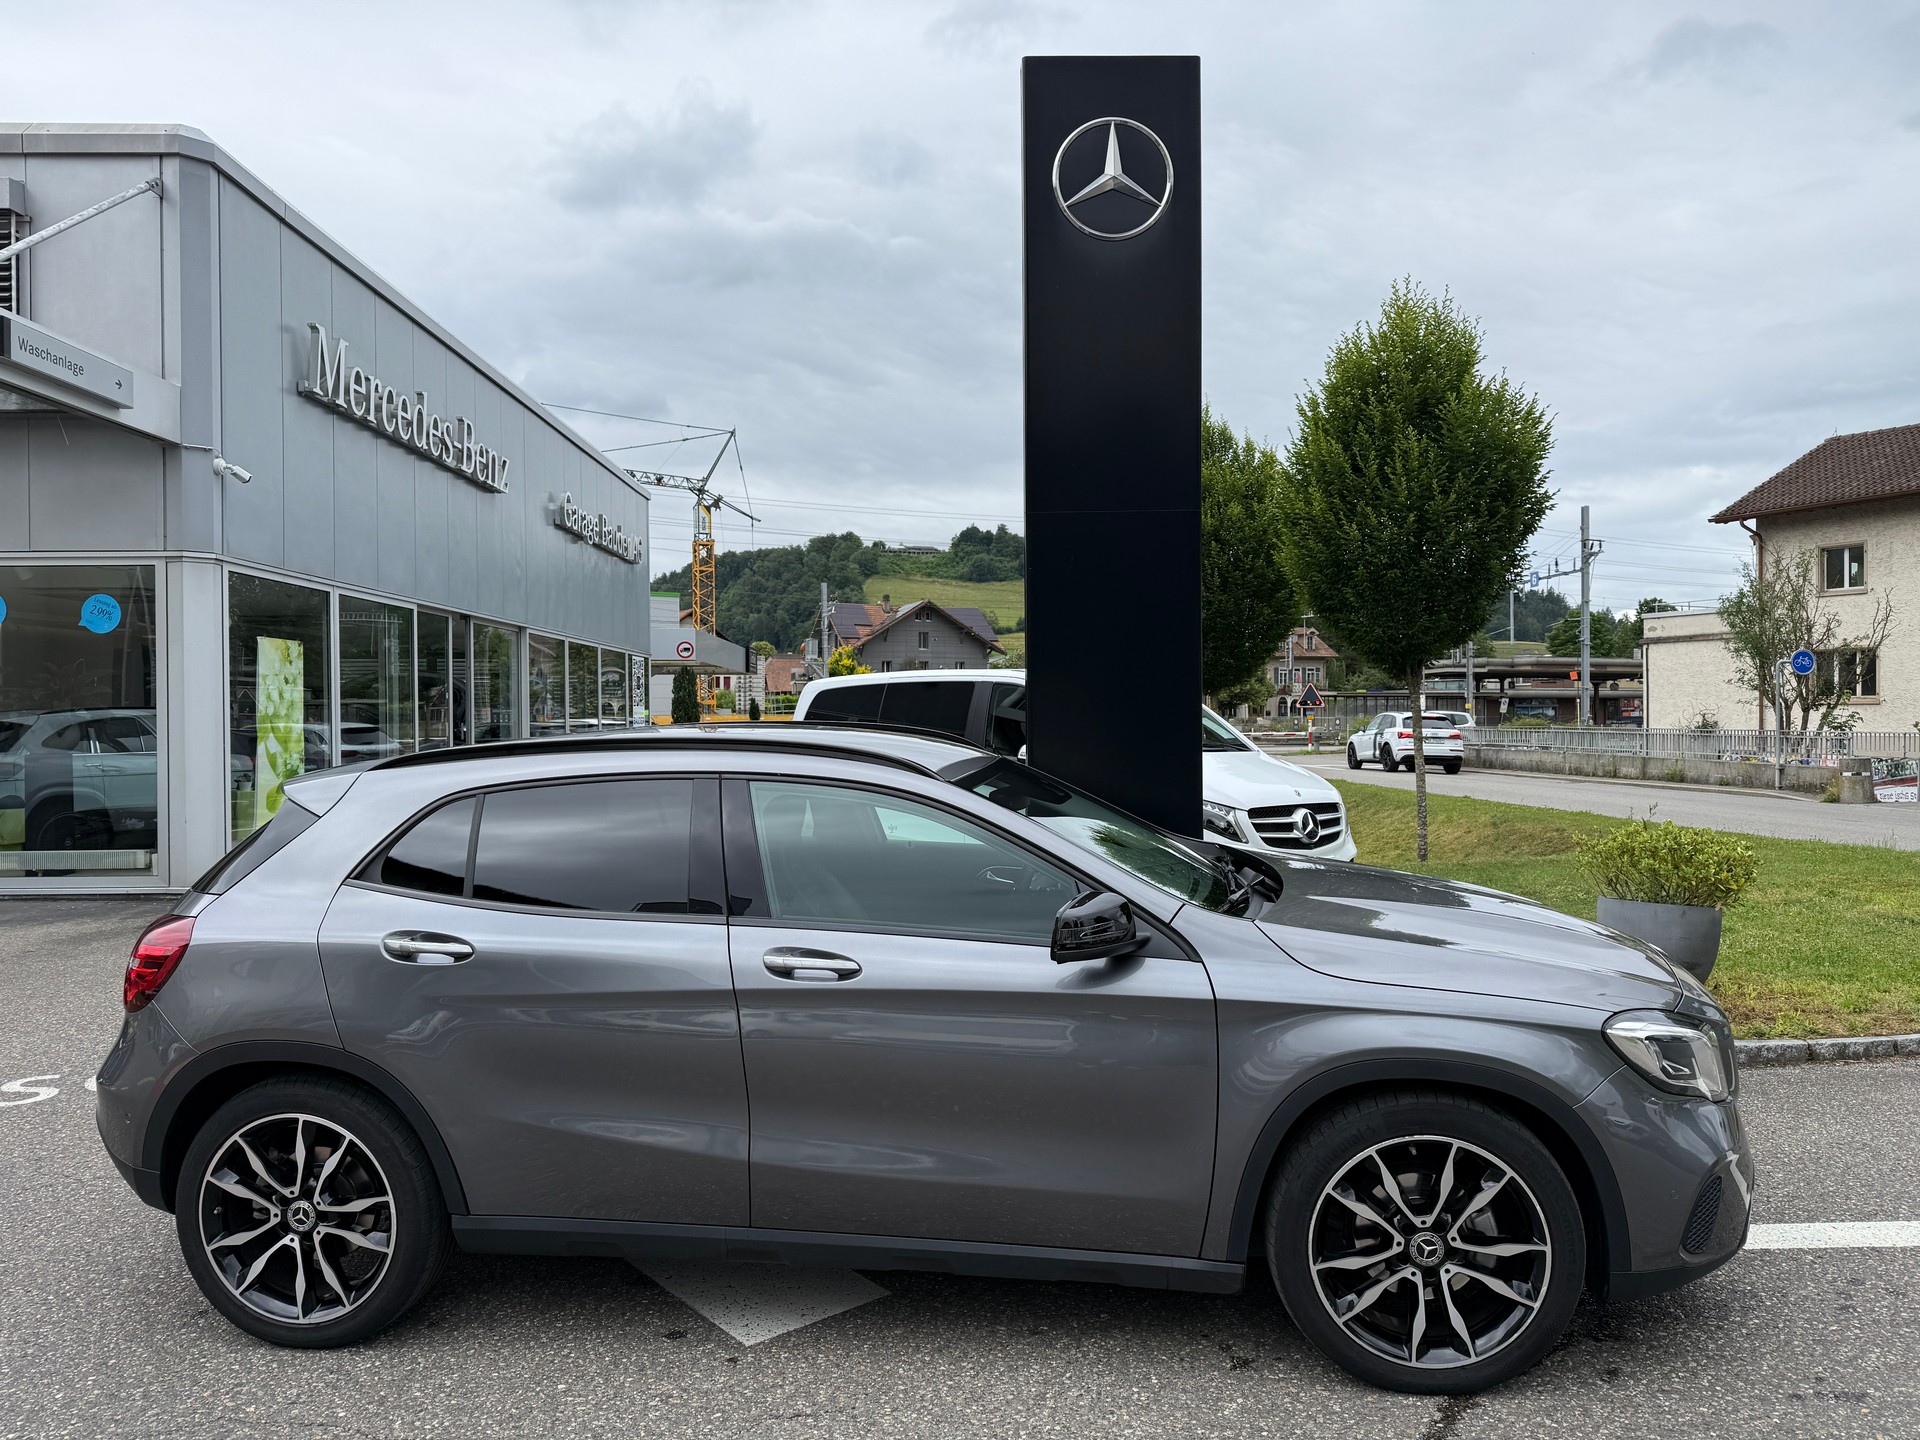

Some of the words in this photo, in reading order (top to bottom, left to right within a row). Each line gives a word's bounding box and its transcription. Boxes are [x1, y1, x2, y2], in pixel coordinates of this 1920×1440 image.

[18, 336, 84, 376] Waschanlage
[309, 322, 510, 493] Mercedes-Benz
[565, 491, 600, 544] Garage
[90, 605, 114, 621] 2.99%
